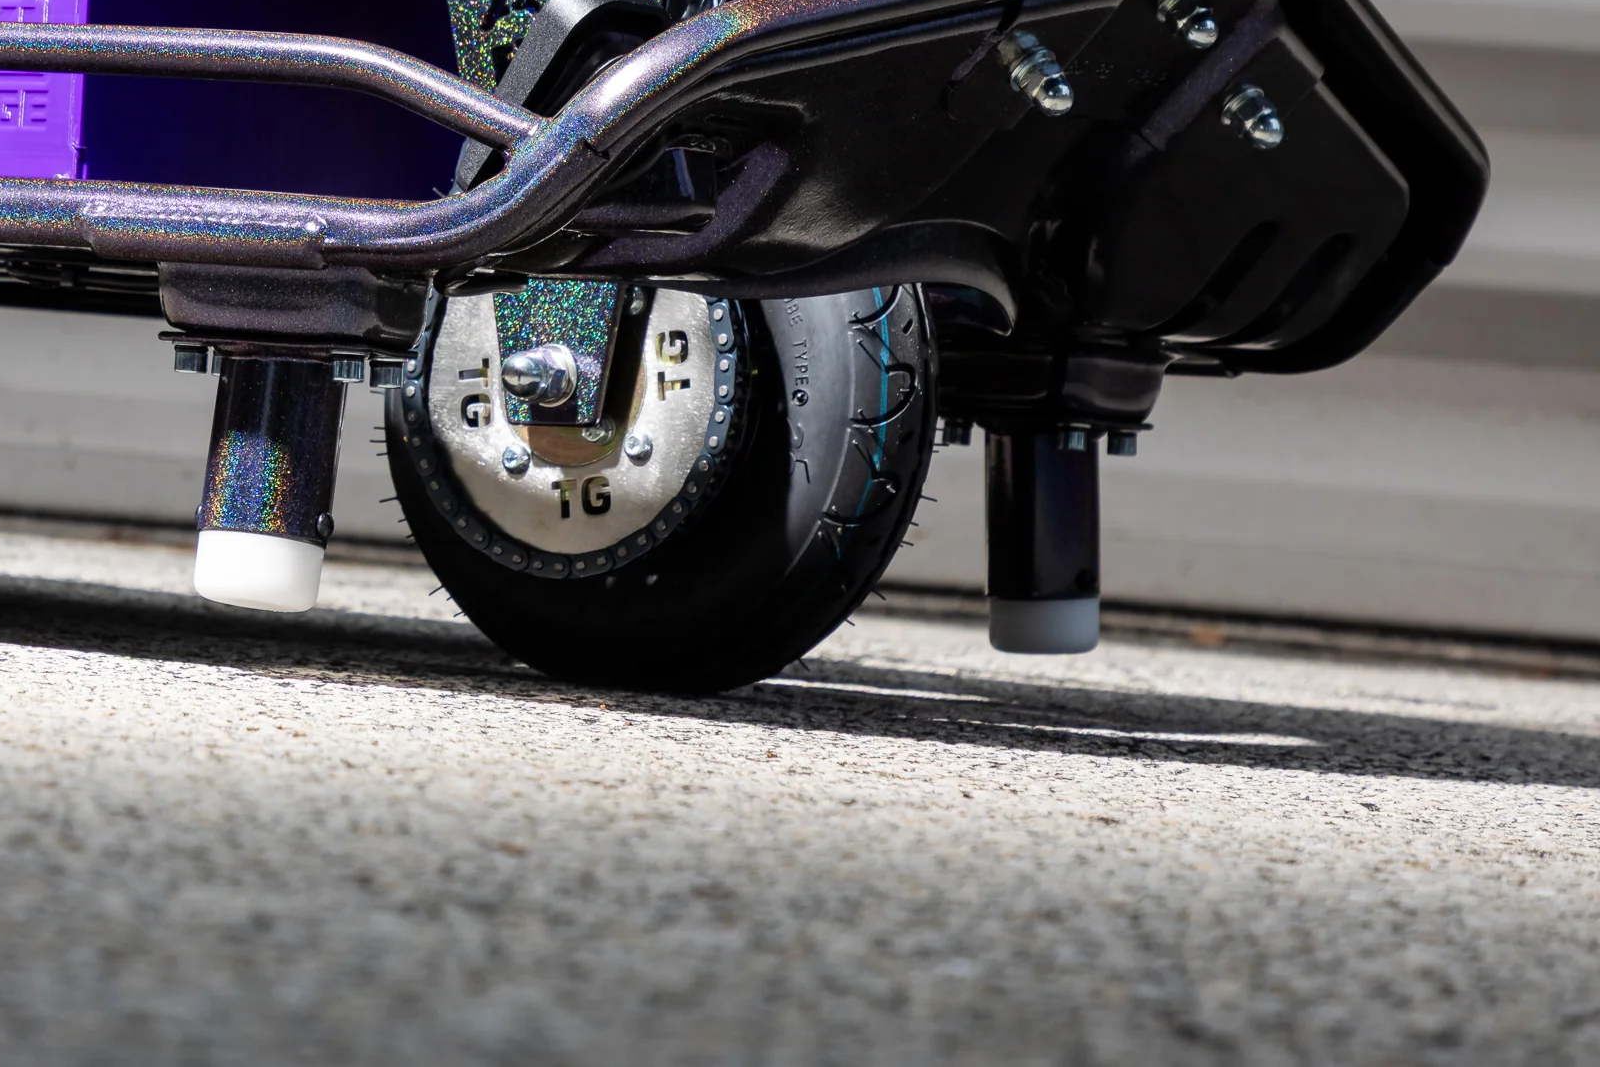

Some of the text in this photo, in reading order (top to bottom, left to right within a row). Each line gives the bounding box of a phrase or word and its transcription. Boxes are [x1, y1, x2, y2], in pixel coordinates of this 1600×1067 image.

[655, 329, 691, 401] TG
[793, 337, 809, 386] TYPE
[457, 357, 493, 429] TG
[551, 475, 612, 519] TG
